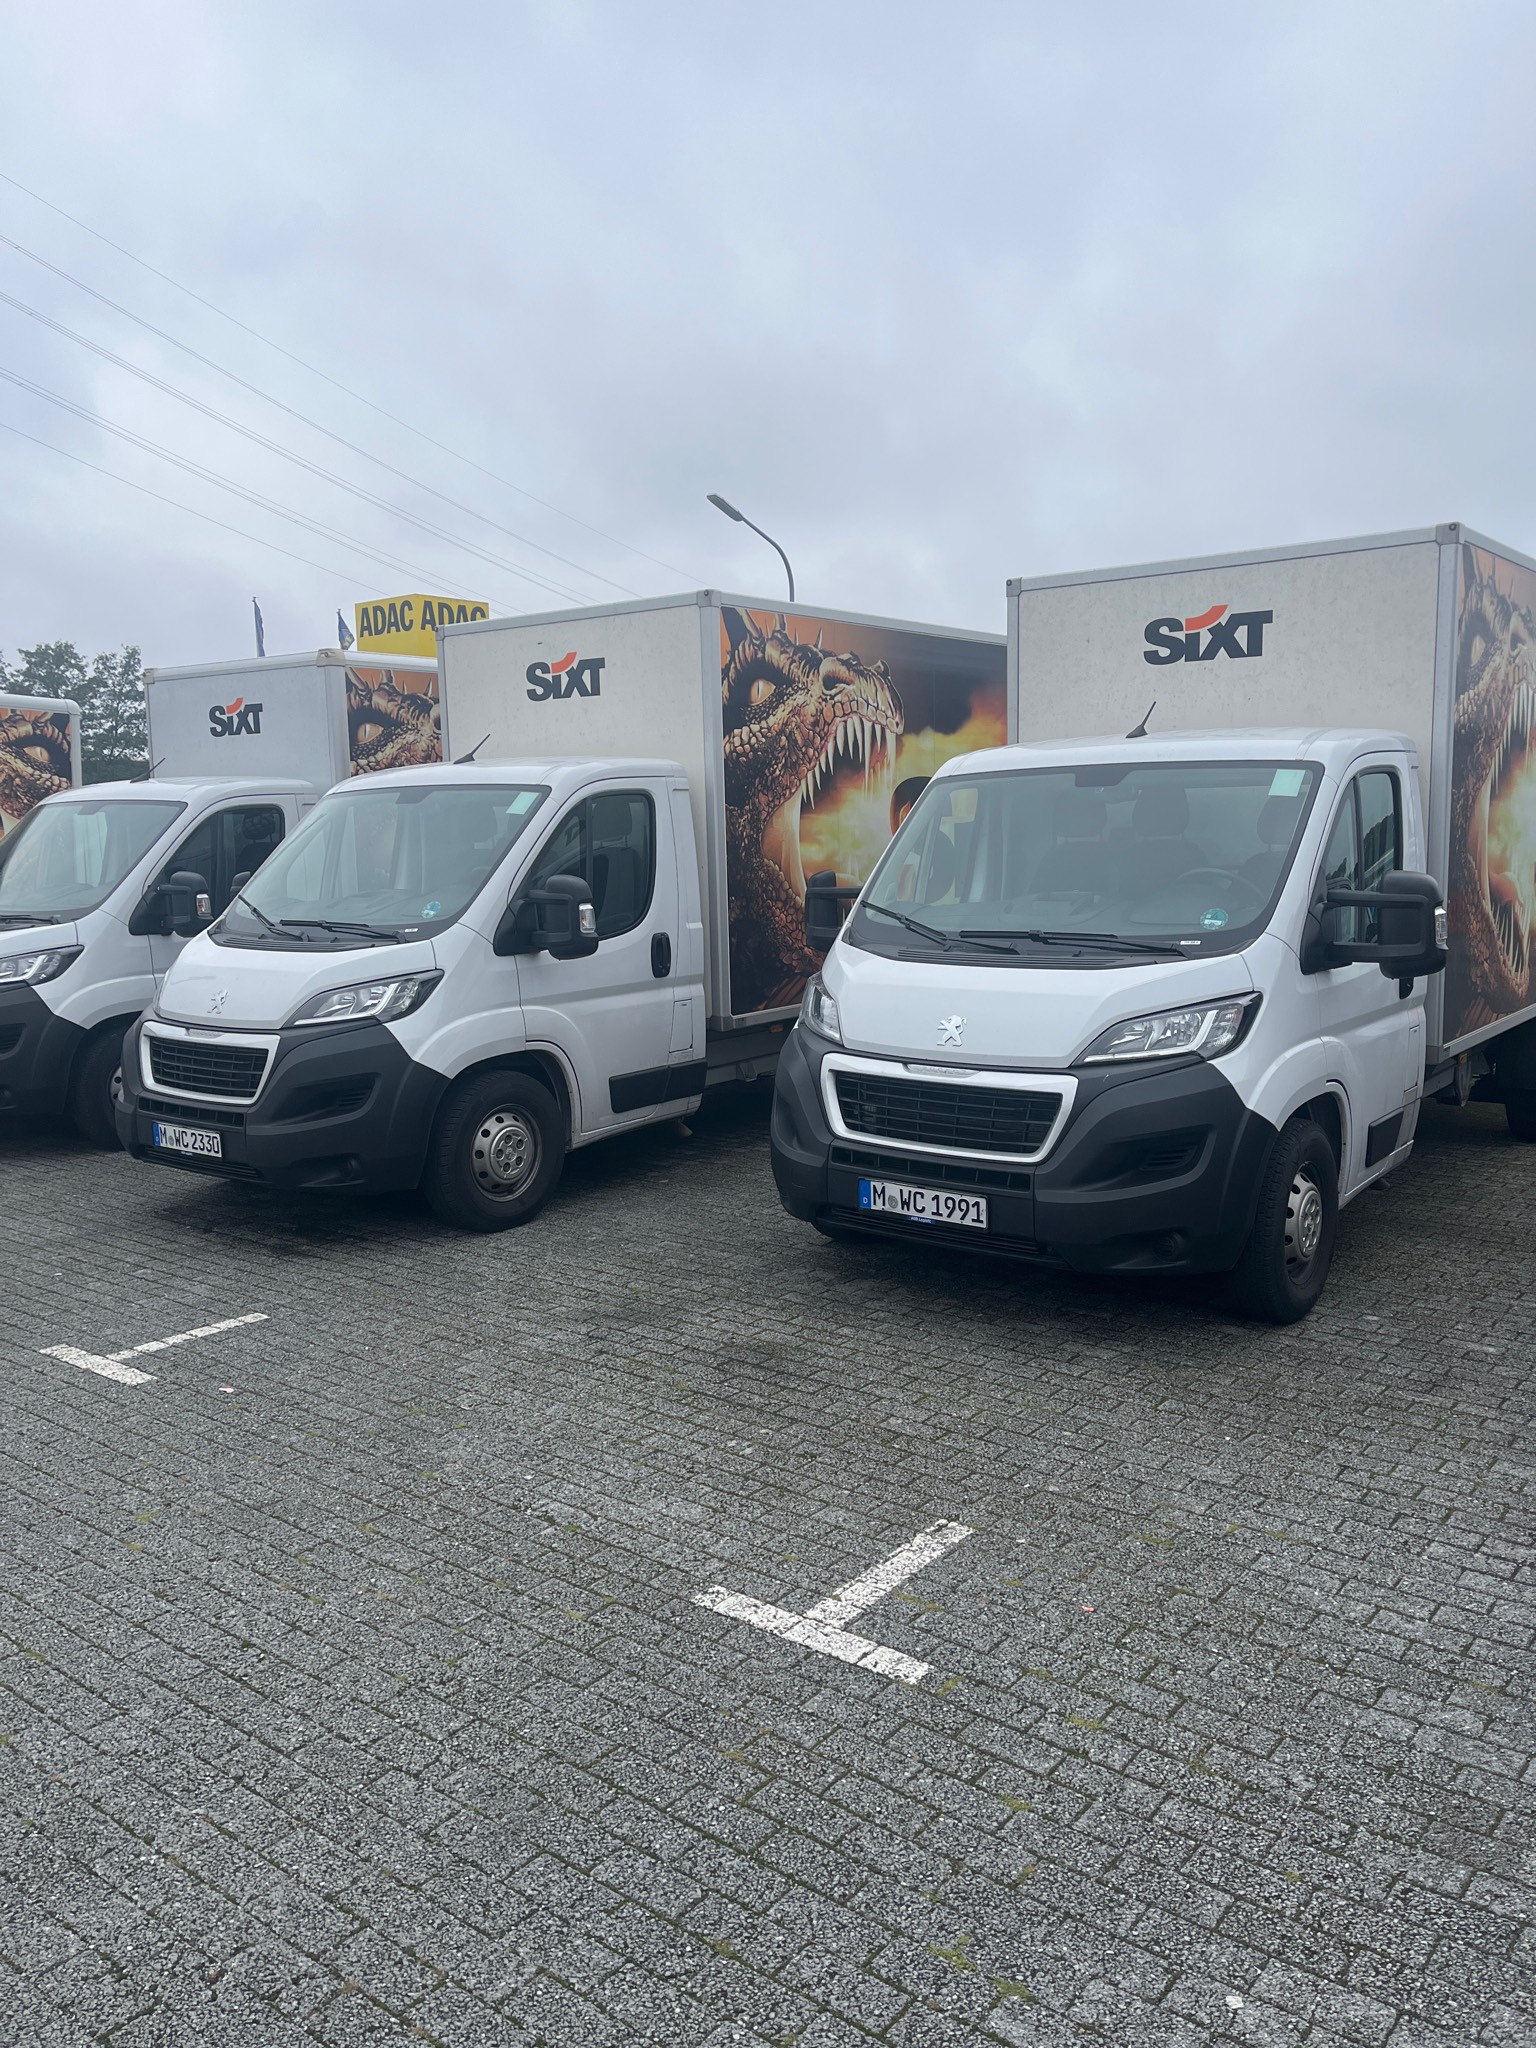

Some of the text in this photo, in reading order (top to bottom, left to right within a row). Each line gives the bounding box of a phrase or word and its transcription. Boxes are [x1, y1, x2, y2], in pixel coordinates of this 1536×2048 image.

[360, 600, 414, 638] ADAC
[159, 1126, 168, 1145] M
[190, 1132, 220, 1154] 2330
[872, 1184, 984, 1224] M WC 1991
